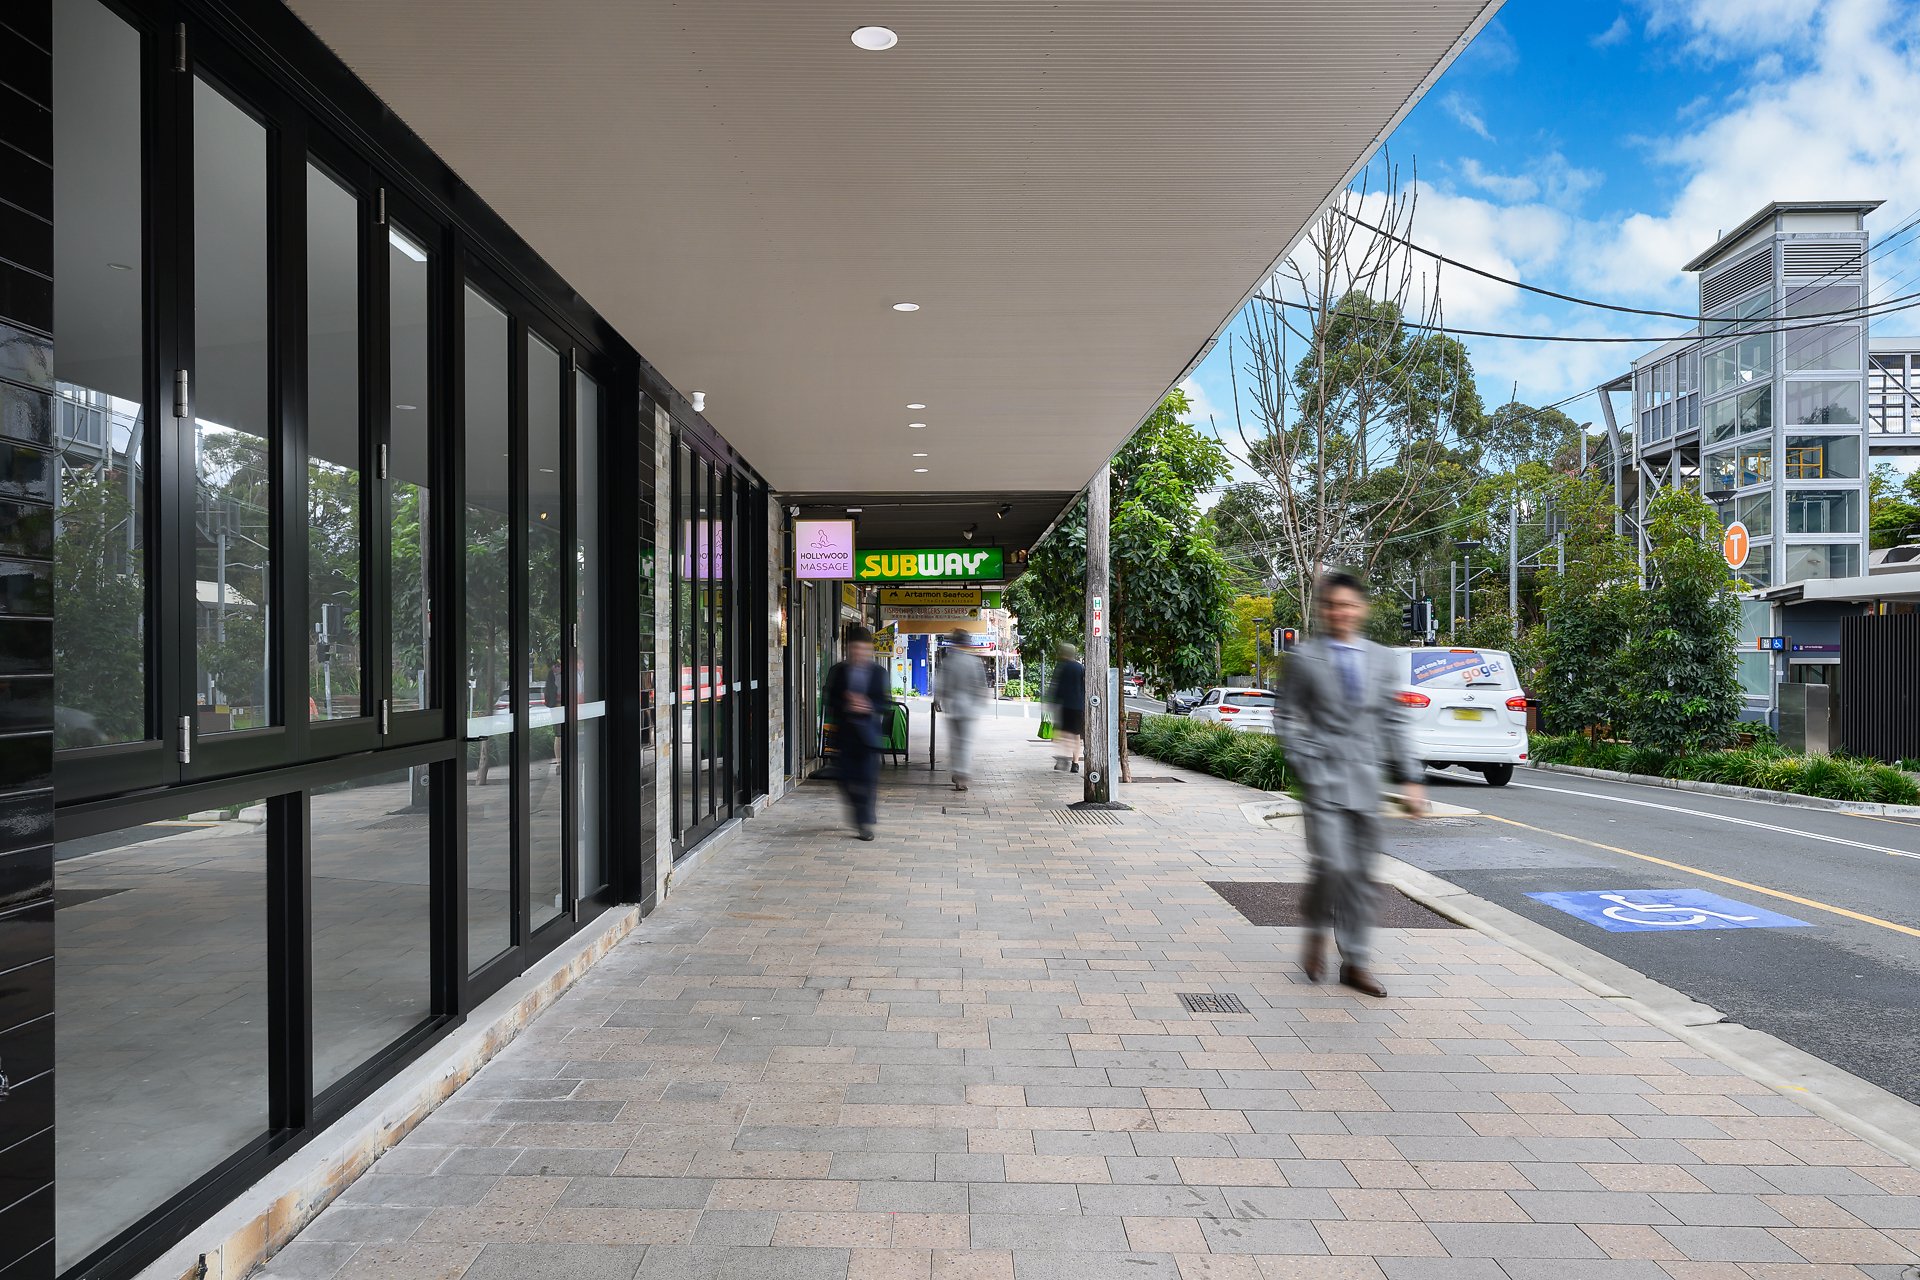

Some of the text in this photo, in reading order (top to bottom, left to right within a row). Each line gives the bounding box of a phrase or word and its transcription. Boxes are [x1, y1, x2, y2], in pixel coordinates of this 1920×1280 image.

[1730, 533, 1742, 561] T
[800, 552, 849, 560] HOLLYWOOD
[800, 562, 849, 571] MASSAGE
[860, 551, 990, 579] SUBWAY
[917, 607, 941, 615] BURGERS
[944, 607, 968, 615] SKEWERS
[1413, 664, 1427, 674] get
[1462, 660, 1504, 682] goget
